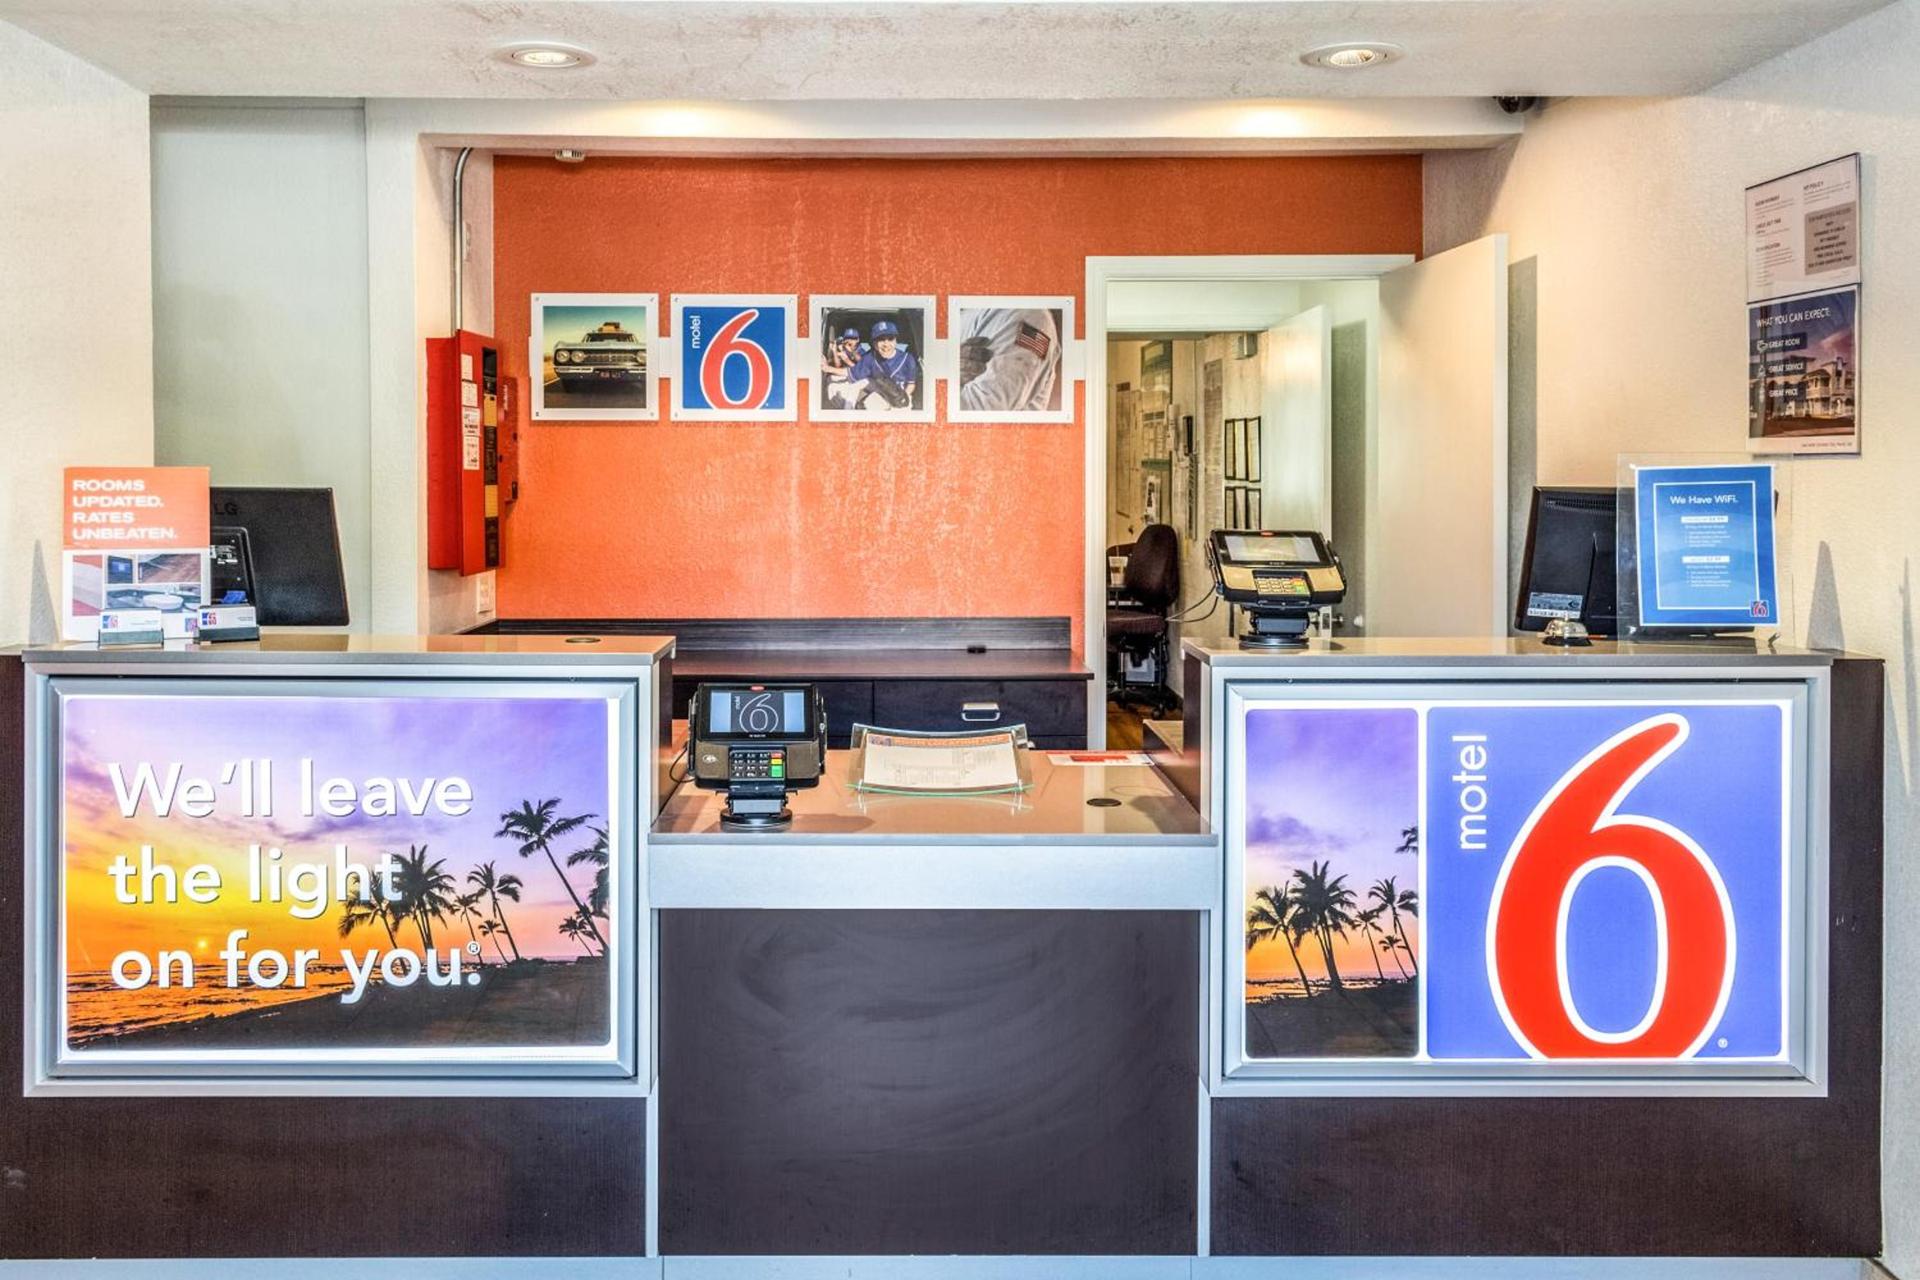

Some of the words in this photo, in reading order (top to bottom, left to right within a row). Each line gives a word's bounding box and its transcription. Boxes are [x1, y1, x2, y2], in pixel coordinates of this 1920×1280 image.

[689, 315, 701, 349] motel
[1756, 316, 1773, 328] WHAT
[1774, 313, 1788, 325] YOU
[1789, 311, 1803, 323] CAN
[700, 309, 773, 410] 6
[72, 479, 145, 492] ROOMS
[72, 495, 164, 508] UPDATED.
[1670, 495, 1686, 504] We
[1688, 495, 1712, 504] Have
[72, 511, 135, 524] RATES
[72, 527, 177, 540] UNBEATEN.
[739, 693, 779, 732] 6
[301, 758, 473, 817] leave
[1452, 735, 1487, 850] motel
[108, 845, 222, 904] the
[248, 844, 403, 919] light
[1485, 713, 1737, 1059] 6
[110, 948, 192, 990] on
[219, 929, 320, 988] for
